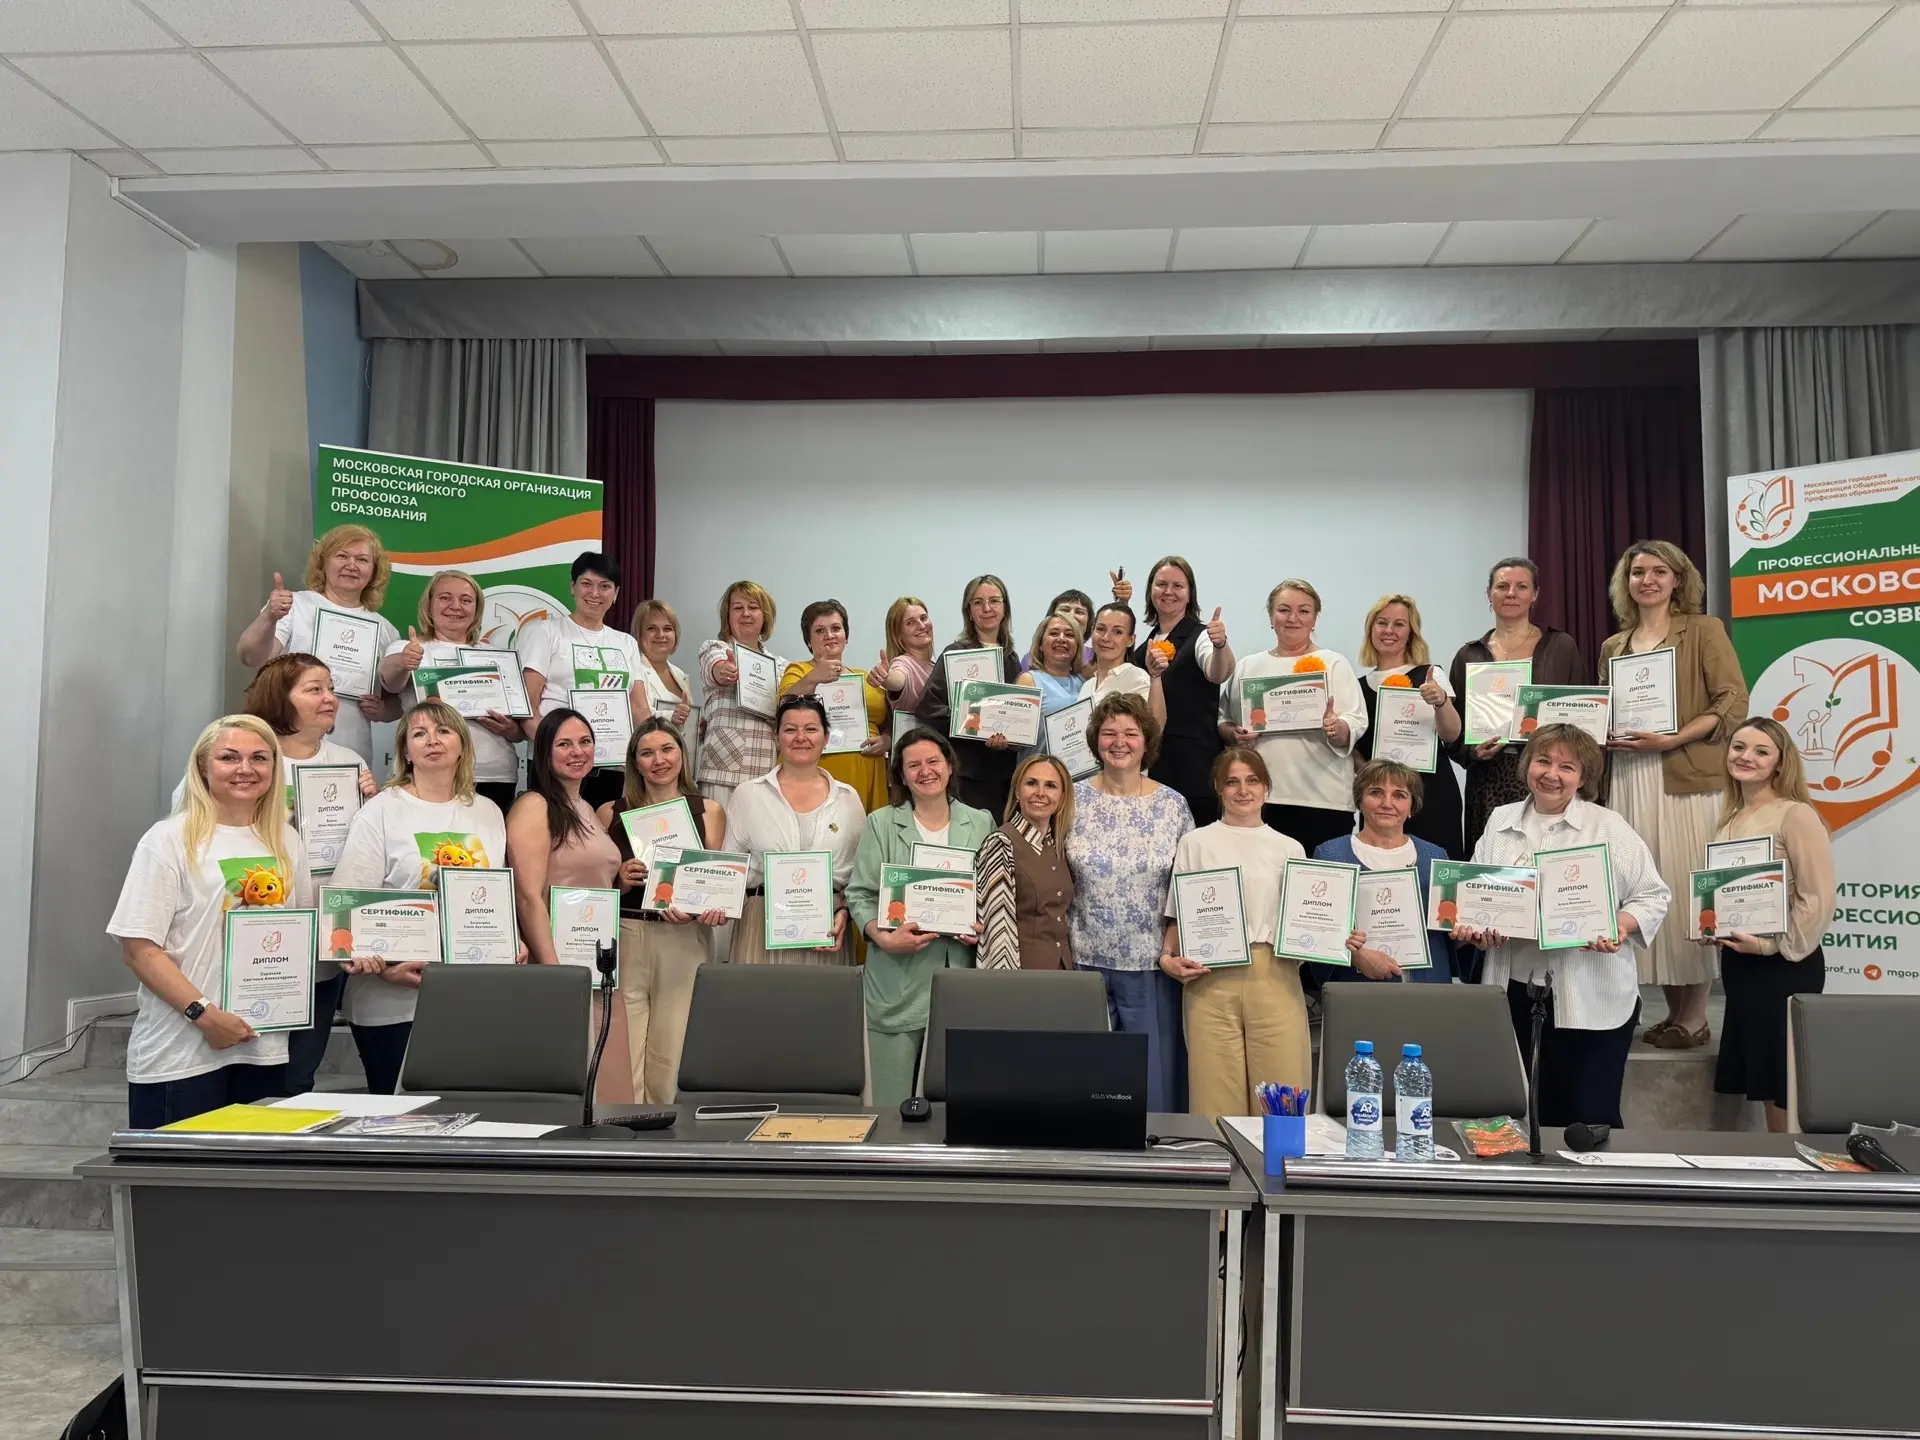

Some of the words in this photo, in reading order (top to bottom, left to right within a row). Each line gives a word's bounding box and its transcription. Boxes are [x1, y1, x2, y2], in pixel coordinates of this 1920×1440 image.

[333, 457, 423, 479] МОСКОВСКАЯ
[426, 470, 501, 489] ГОРОДСКАЯ
[504, 480, 592, 500] ОРГАНИЗАЦИЯ
[1803, 479, 1847, 489] Московская
[1848, 473, 1888, 483] городская
[332, 472, 467, 498] ОБЩЕРОССИЙСКОГО
[332, 486, 418, 507] ПРОФСОЮЗА
[331, 501, 427, 522] ОБРАЗОВАНИЯ
[1758, 567, 1920, 604] МОСКОВС
[333, 643, 359, 654] ДИПЛОМ
[1269, 688, 1317, 697] СЕРТИФИКАТ
[1629, 683, 1656, 693] ДИПЛОМ
[1546, 701, 1600, 709] СЕРТИФИКАТ
[590, 716, 615, 724] ДИПЛОМ
[318, 805, 345, 813] ДИПЛОМ
[651, 833, 678, 845] ДИПЛОМ
[684, 866, 737, 877] СЕРТИФИКАТ
[785, 887, 813, 896] ДИПЛОМ
[912, 884, 965, 894] СЕРТИФИКАТ
[1465, 882, 1526, 893] СЕРТИФИКАТ
[1558, 884, 1588, 893] ДИПЛОМ
[1721, 882, 1774, 893] СЕРТИФИКАТ
[1302, 899, 1333, 908] ДИПЛОМ
[360, 908, 426, 917] СЕРТИФИКАТ
[1196, 906, 1224, 914] ДИПЛОМ
[1371, 907, 1401, 916] ДИПЛОМ
[570, 925, 599, 933] ДИПЛОМ
[1821, 933, 1897, 950] ВИТИЯ
[252, 956, 289, 965] ДИПЛОМ
[1887, 970, 1919, 979] mgop
